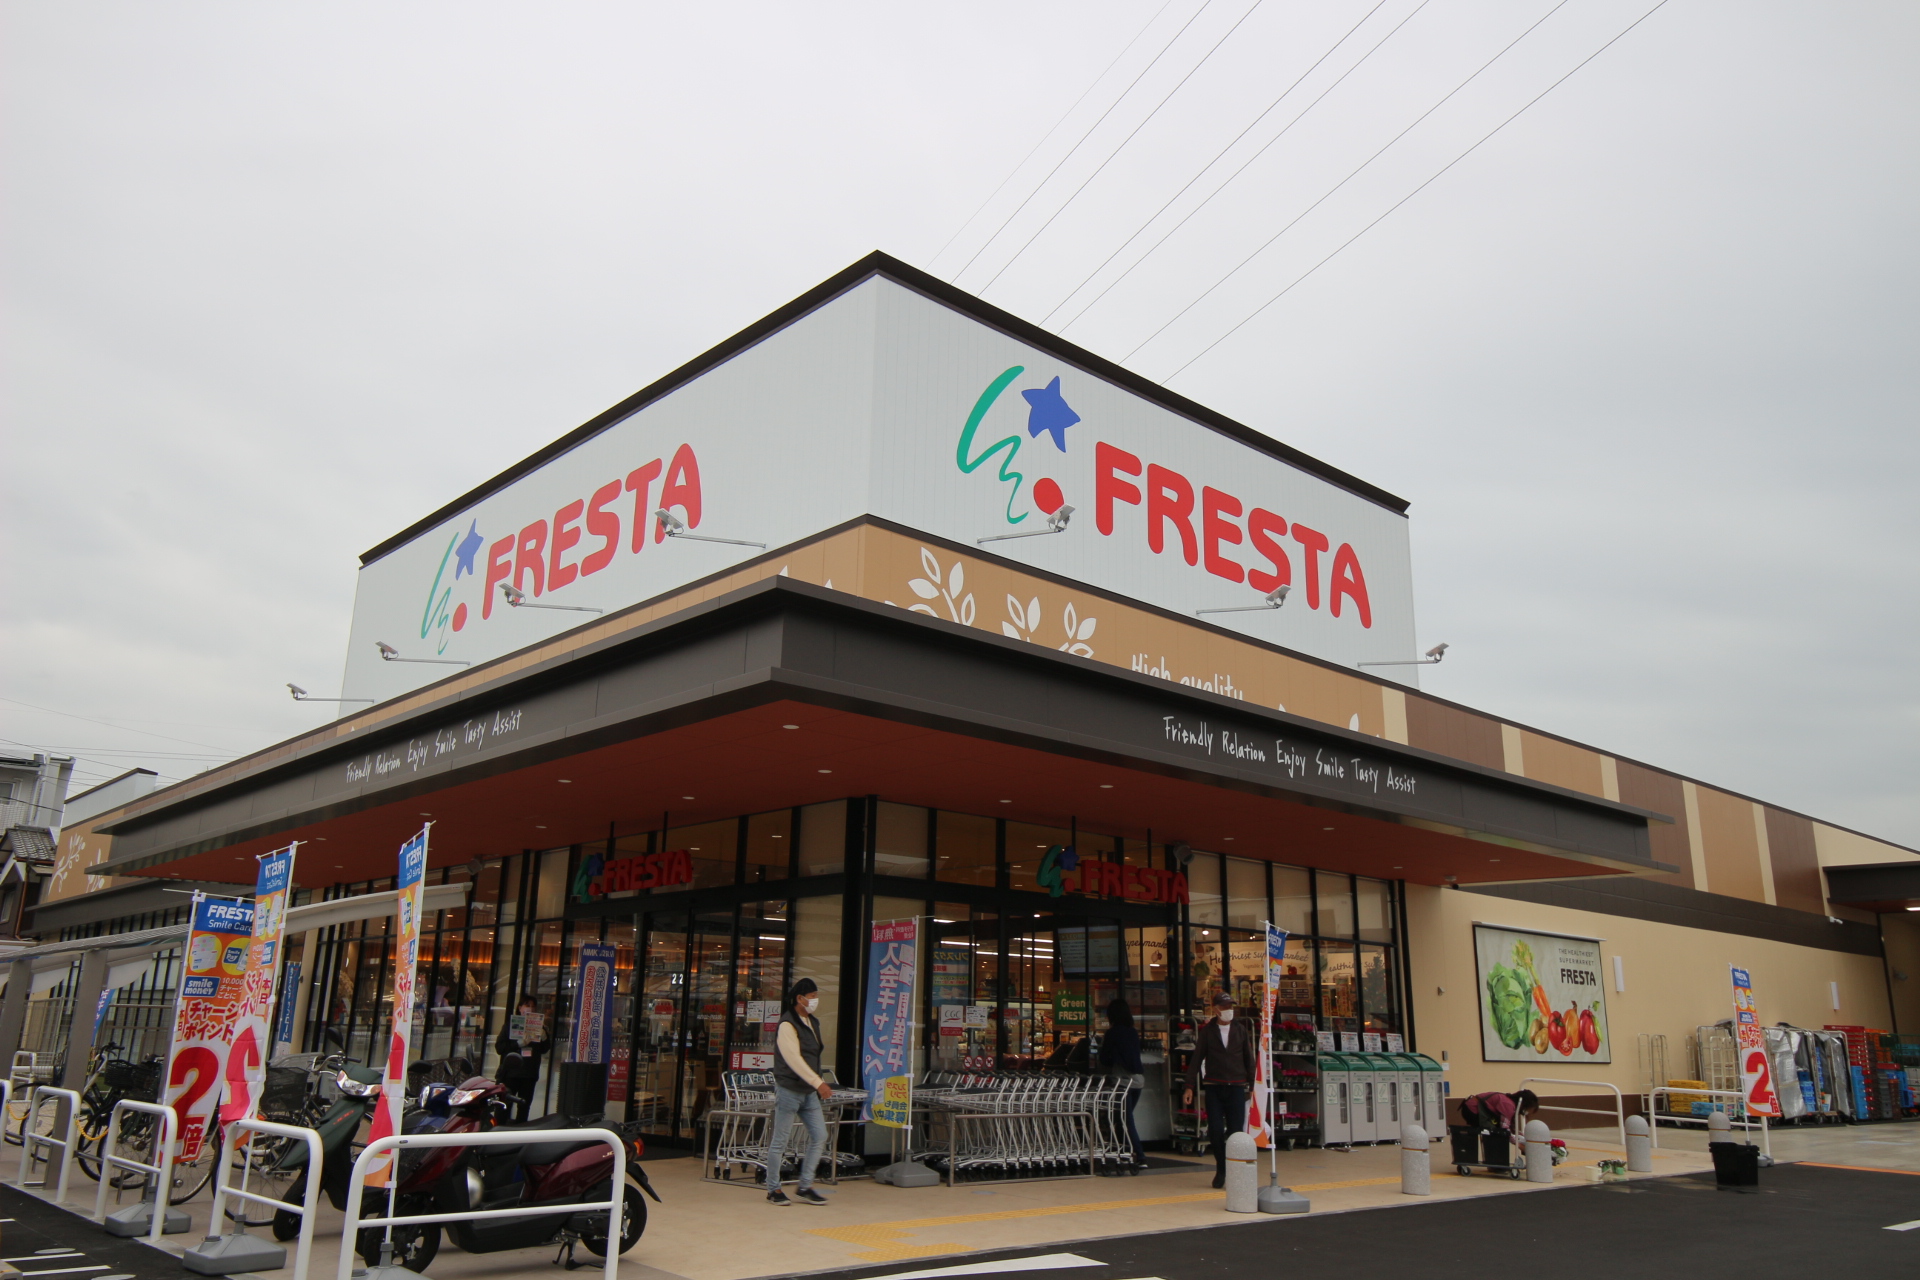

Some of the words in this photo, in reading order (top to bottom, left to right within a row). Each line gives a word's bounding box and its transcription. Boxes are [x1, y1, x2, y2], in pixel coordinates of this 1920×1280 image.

[482, 443, 702, 620] FRESTA
[1095, 441, 1372, 629] FRESTA
[346, 755, 372, 783] Friendly
[375, 753, 401, 775] Relation
[407, 739, 428, 772] Enjoy
[435, 729, 456, 757] Smile
[463, 719, 486, 751] Tasty
[491, 709, 522, 736] Assist
[1163, 716, 1213, 755] Friendly
[1222, 731, 1266, 762] Relation
[1276, 739, 1306, 779] Enjoy
[1316, 748, 1344, 779] Smile
[1351, 758, 1378, 793] Tasty
[1387, 766, 1416, 794] Assist
[602, 849, 693, 893] FRESTA
[1080, 859, 1190, 905] FRESTA
[208, 919, 233, 930] Smile
[1559, 957, 1594, 966] SUPERMARKET
[188, 978, 213, 987] smile
[671, 973, 677, 985] 2
[678, 973, 684, 985] 2
[1560, 968, 1597, 986] FRESTA
[184, 987, 214, 995] money
[189, 1000, 238, 1022] チャージ
[1060, 998, 1086, 1008] Green
[184, 1021, 233, 1041] ポイント
[1746, 1051, 1774, 1104] 2
[162, 1047, 219, 1147] 2
[1769, 1096, 1779, 1114] 倍
[181, 1125, 205, 1158] 倍
